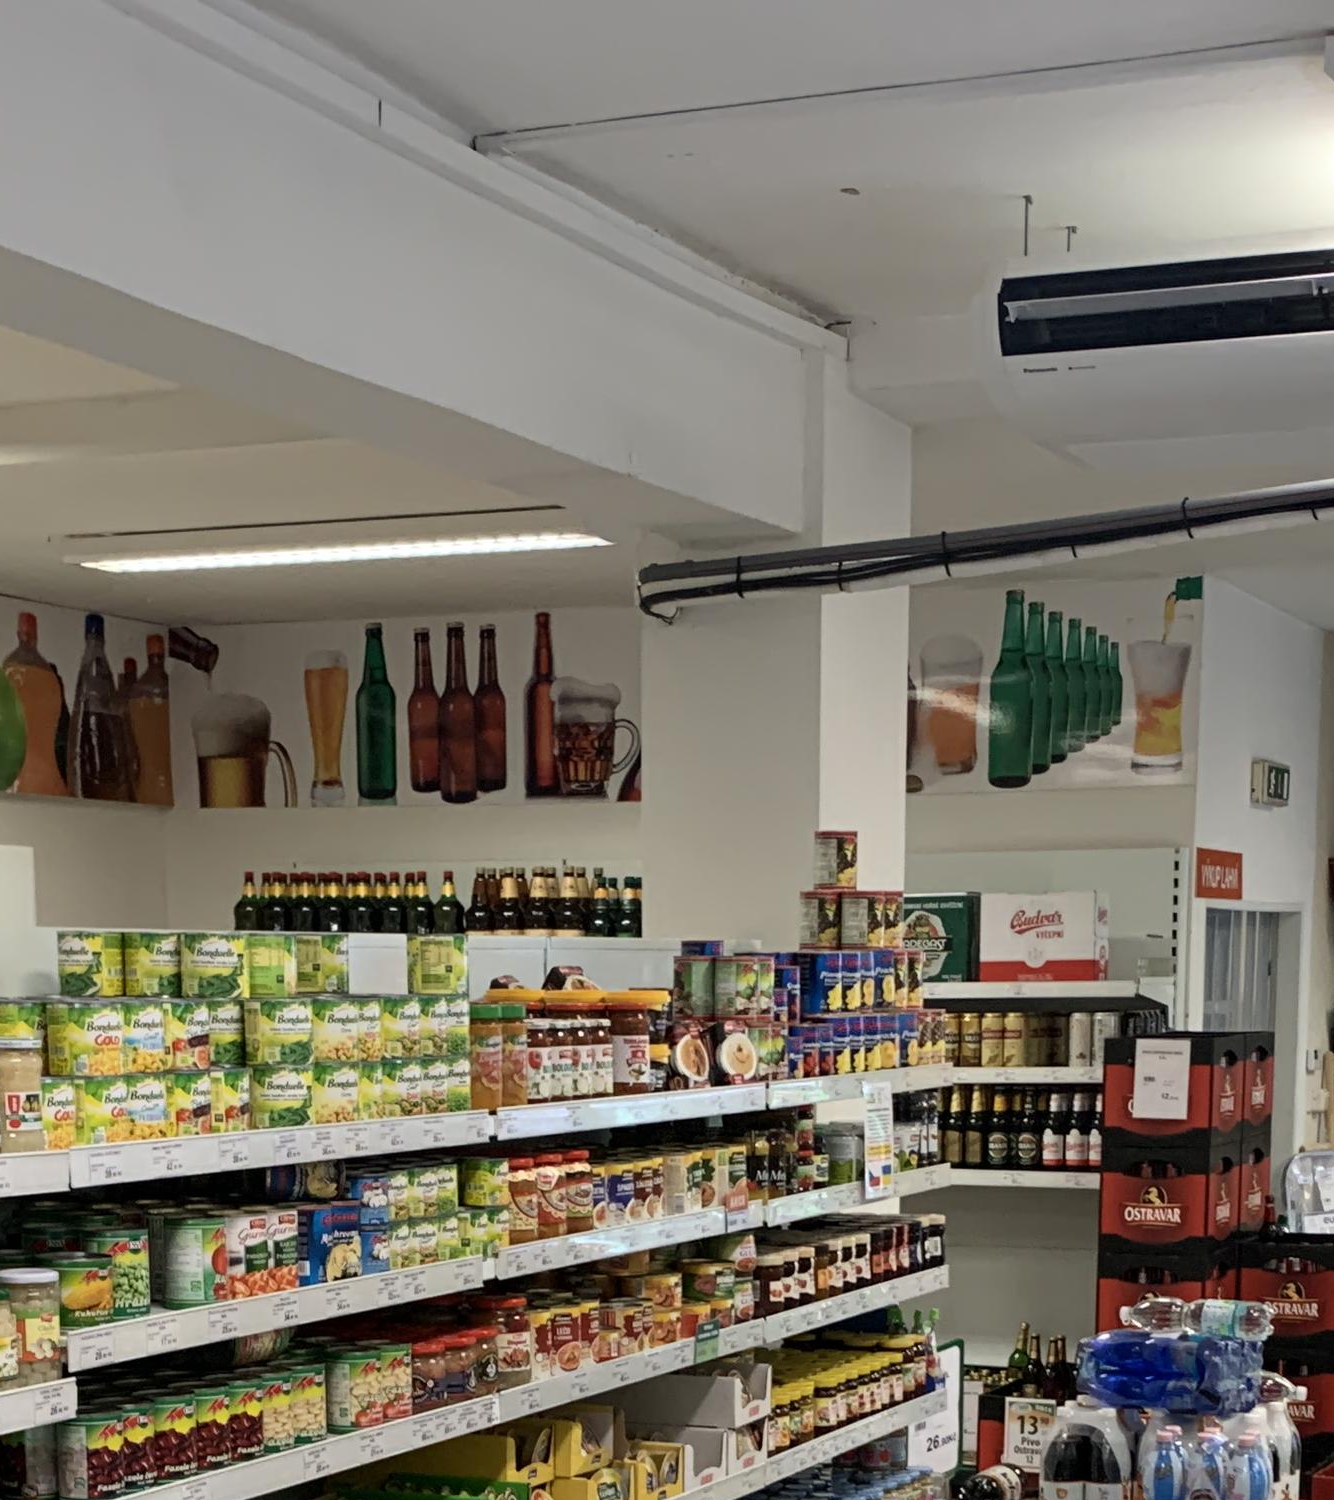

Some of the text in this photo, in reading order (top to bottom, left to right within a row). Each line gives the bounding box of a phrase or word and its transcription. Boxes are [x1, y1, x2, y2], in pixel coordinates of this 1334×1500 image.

[1010, 910, 1064, 935] Budvar
[196, 947, 235, 960] Bonduelle
[1124, 1206, 1182, 1225] OSTRAVAR
[1017, 1415, 1038, 1435] 13
[1021, 1436, 1041, 1447] Pivo
